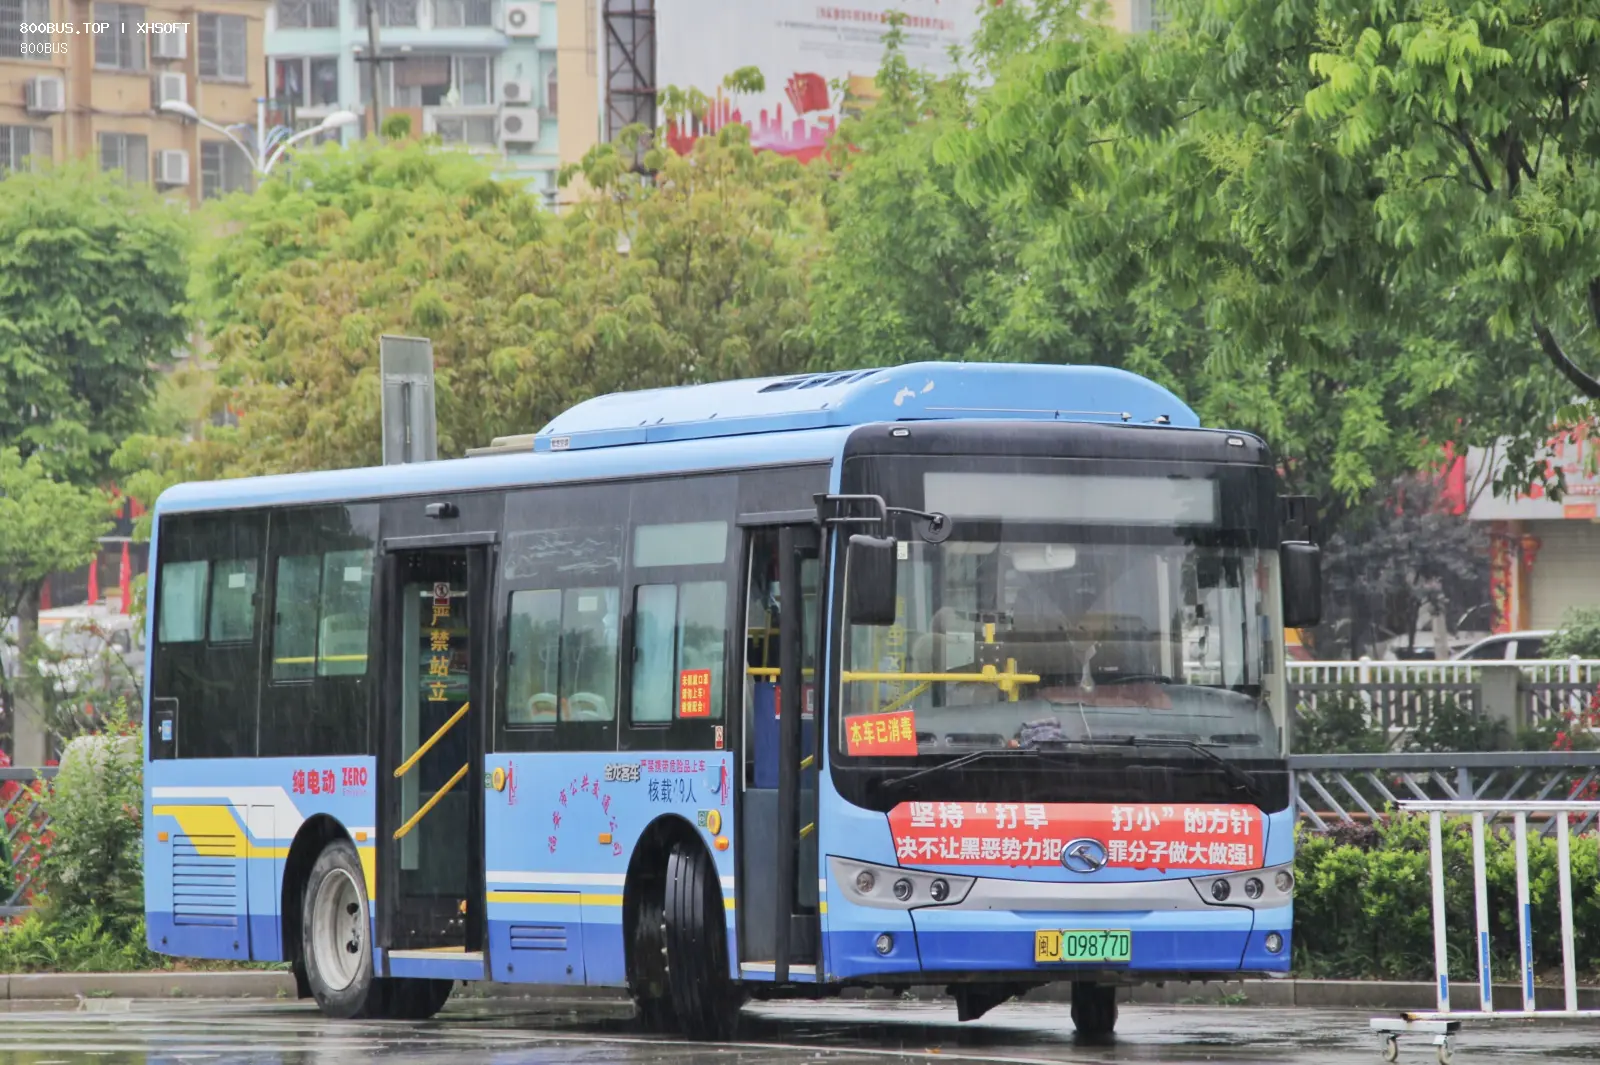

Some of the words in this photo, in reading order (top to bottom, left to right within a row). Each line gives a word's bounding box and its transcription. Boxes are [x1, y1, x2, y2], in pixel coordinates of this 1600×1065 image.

[428, 605, 451, 702] 严禁站立
[850, 716, 913, 748] 本车已消毒
[640, 759, 706, 773] 严禁携带危险品上车
[292, 768, 336, 795] 纯电动
[341, 766, 368, 787] ZERO
[896, 835, 1062, 861] 决不让黑恶势力犯
[1067, 934, 1129, 957] 09877D
